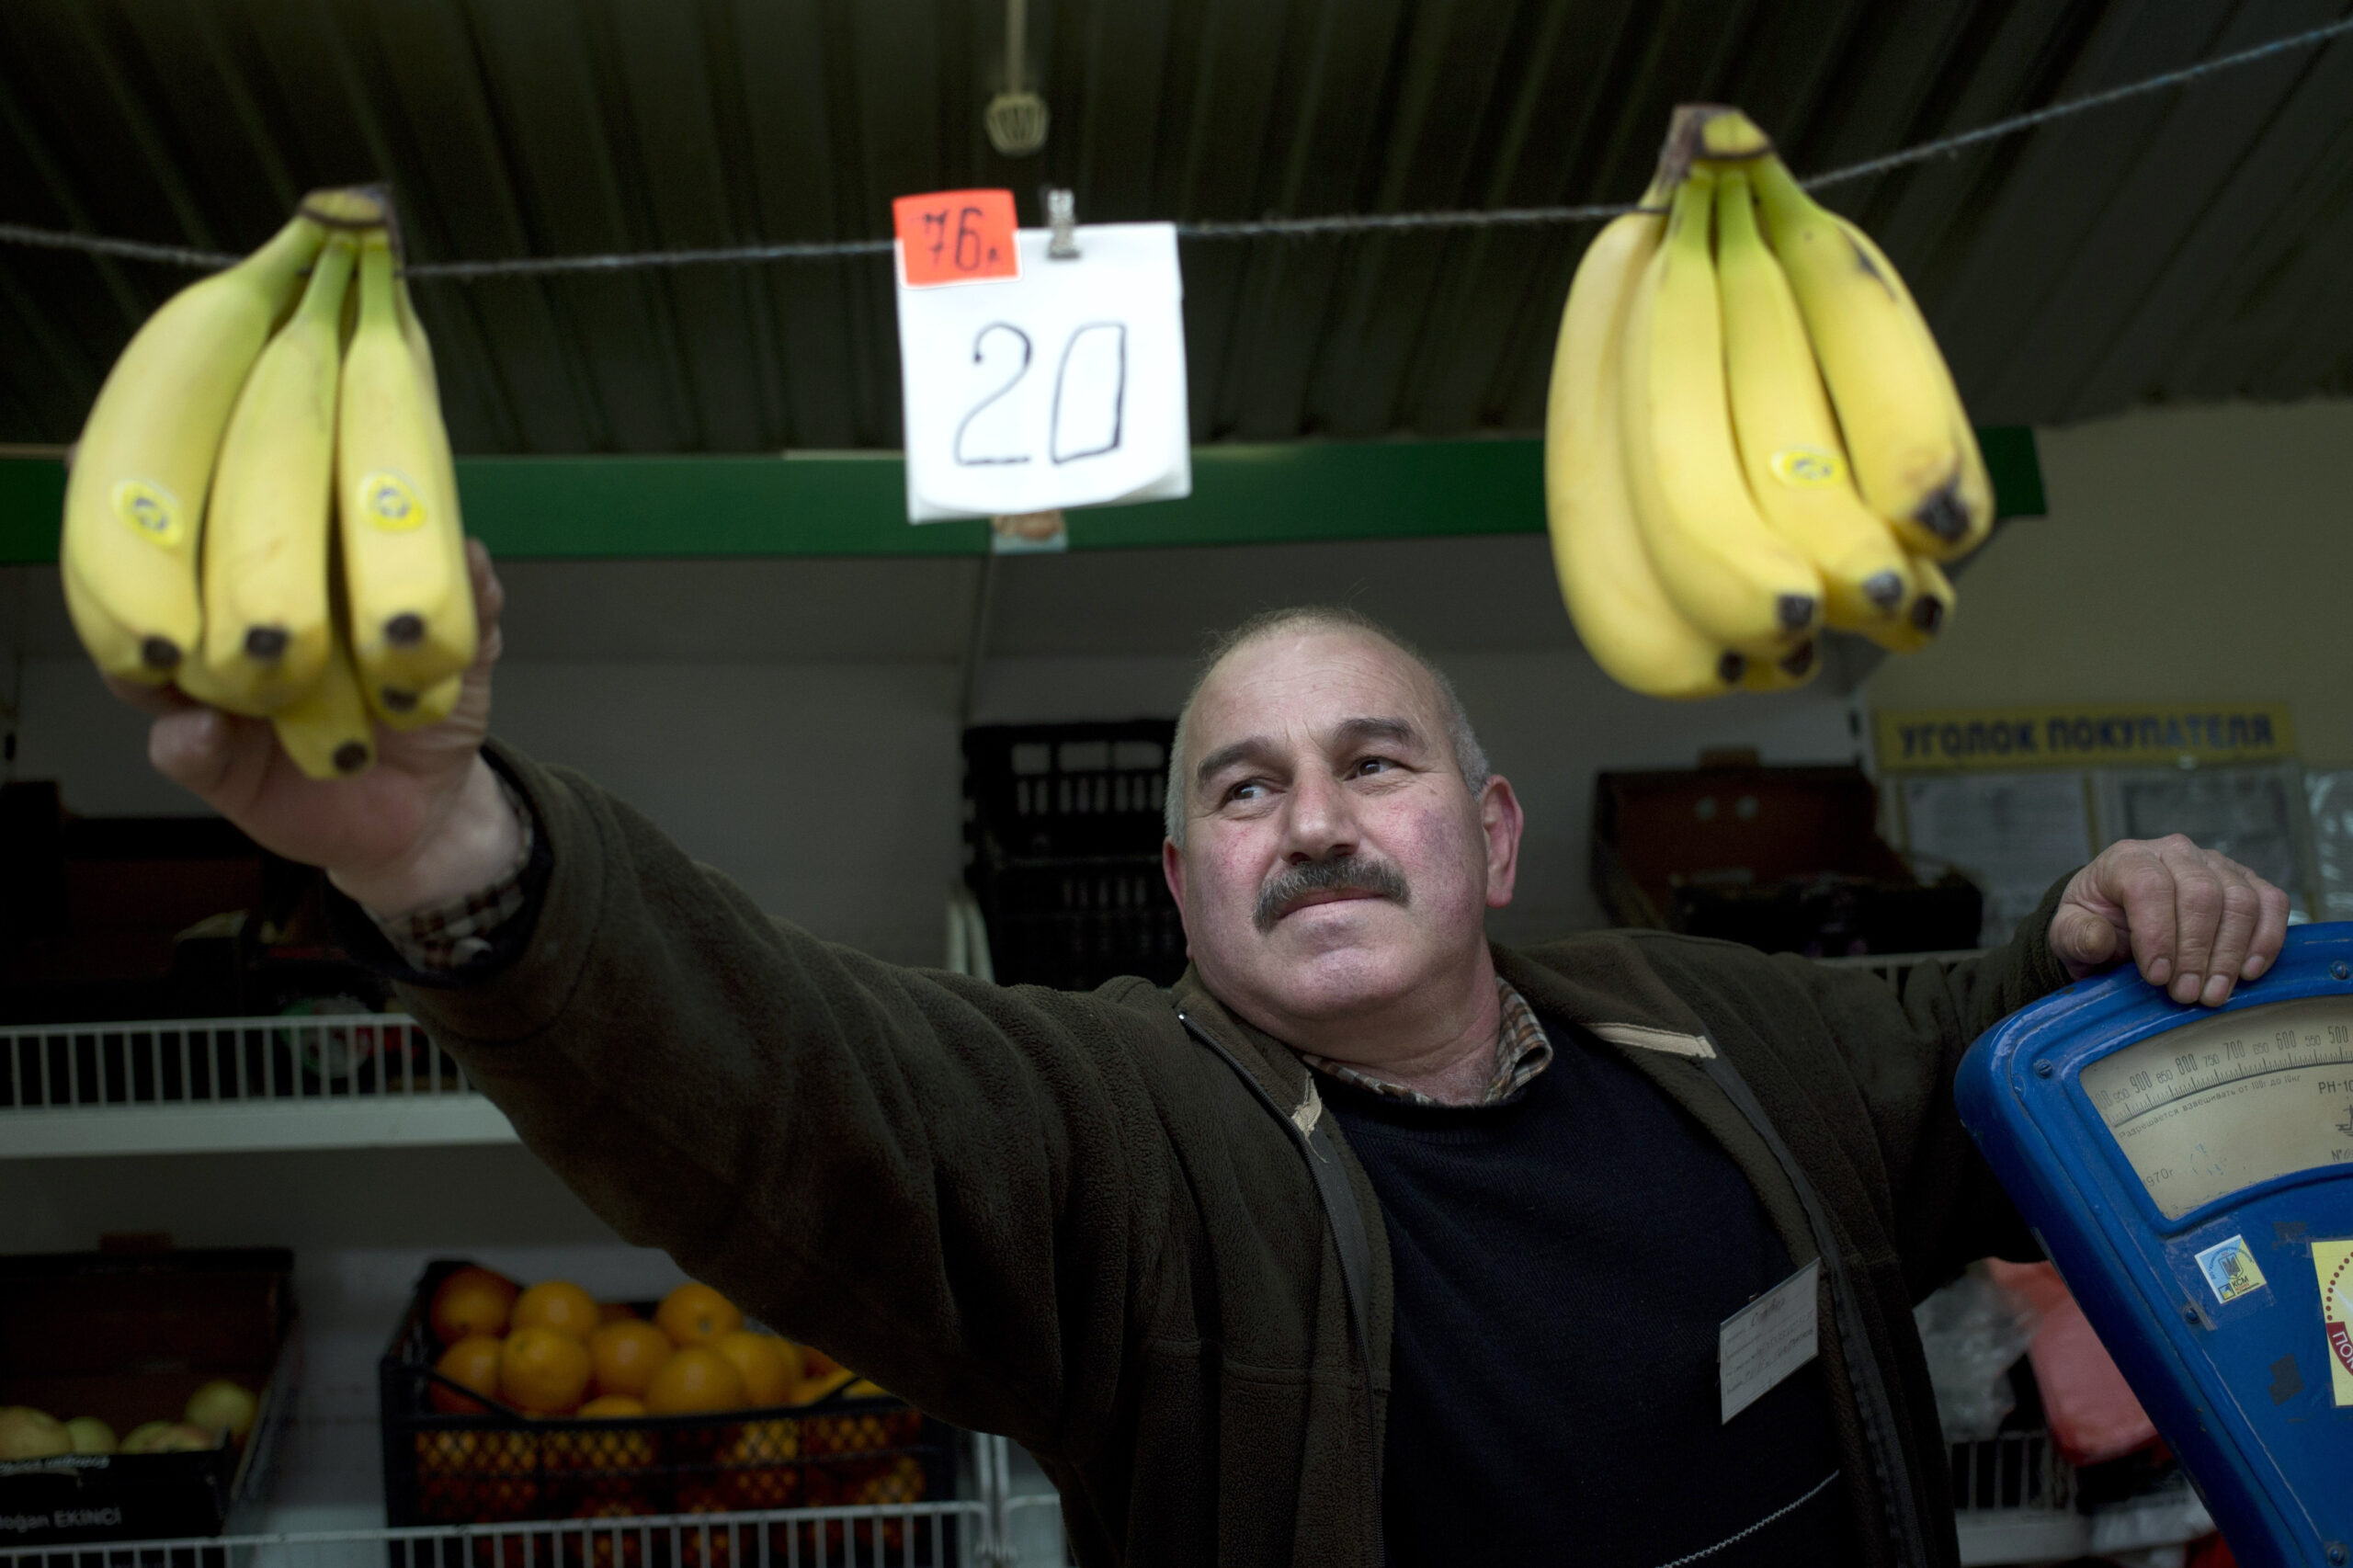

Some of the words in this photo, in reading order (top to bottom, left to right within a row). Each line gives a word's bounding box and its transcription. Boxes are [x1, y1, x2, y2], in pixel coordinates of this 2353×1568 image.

[953, 321, 1127, 466] 20
[1898, 718, 2037, 758] УГОЛОК
[2048, 712, 2275, 753] ПОКУПАТЕЛЯ
[2130, 1071, 2153, 1094] 900
[2156, 1069, 2174, 1084] 850
[2175, 1053, 2198, 1075] 800
[2203, 1053, 2220, 1068] 750
[2222, 1040, 2245, 1061] 700
[2252, 1042, 2269, 1055] 650
[2275, 1029, 2296, 1051] 600
[2304, 1035, 2321, 1047] 550
[2327, 1025, 2349, 1044] 500
[2119, 1108, 2180, 1140] Разрешается
[2182, 1086, 2236, 1112] взвешивать
[2238, 1085, 2248, 1093] от
[2270, 1078, 2281, 1087] до
[2231, 1275, 2249, 1288] КСМ
[0, 1510, 51, 1534] oğan
